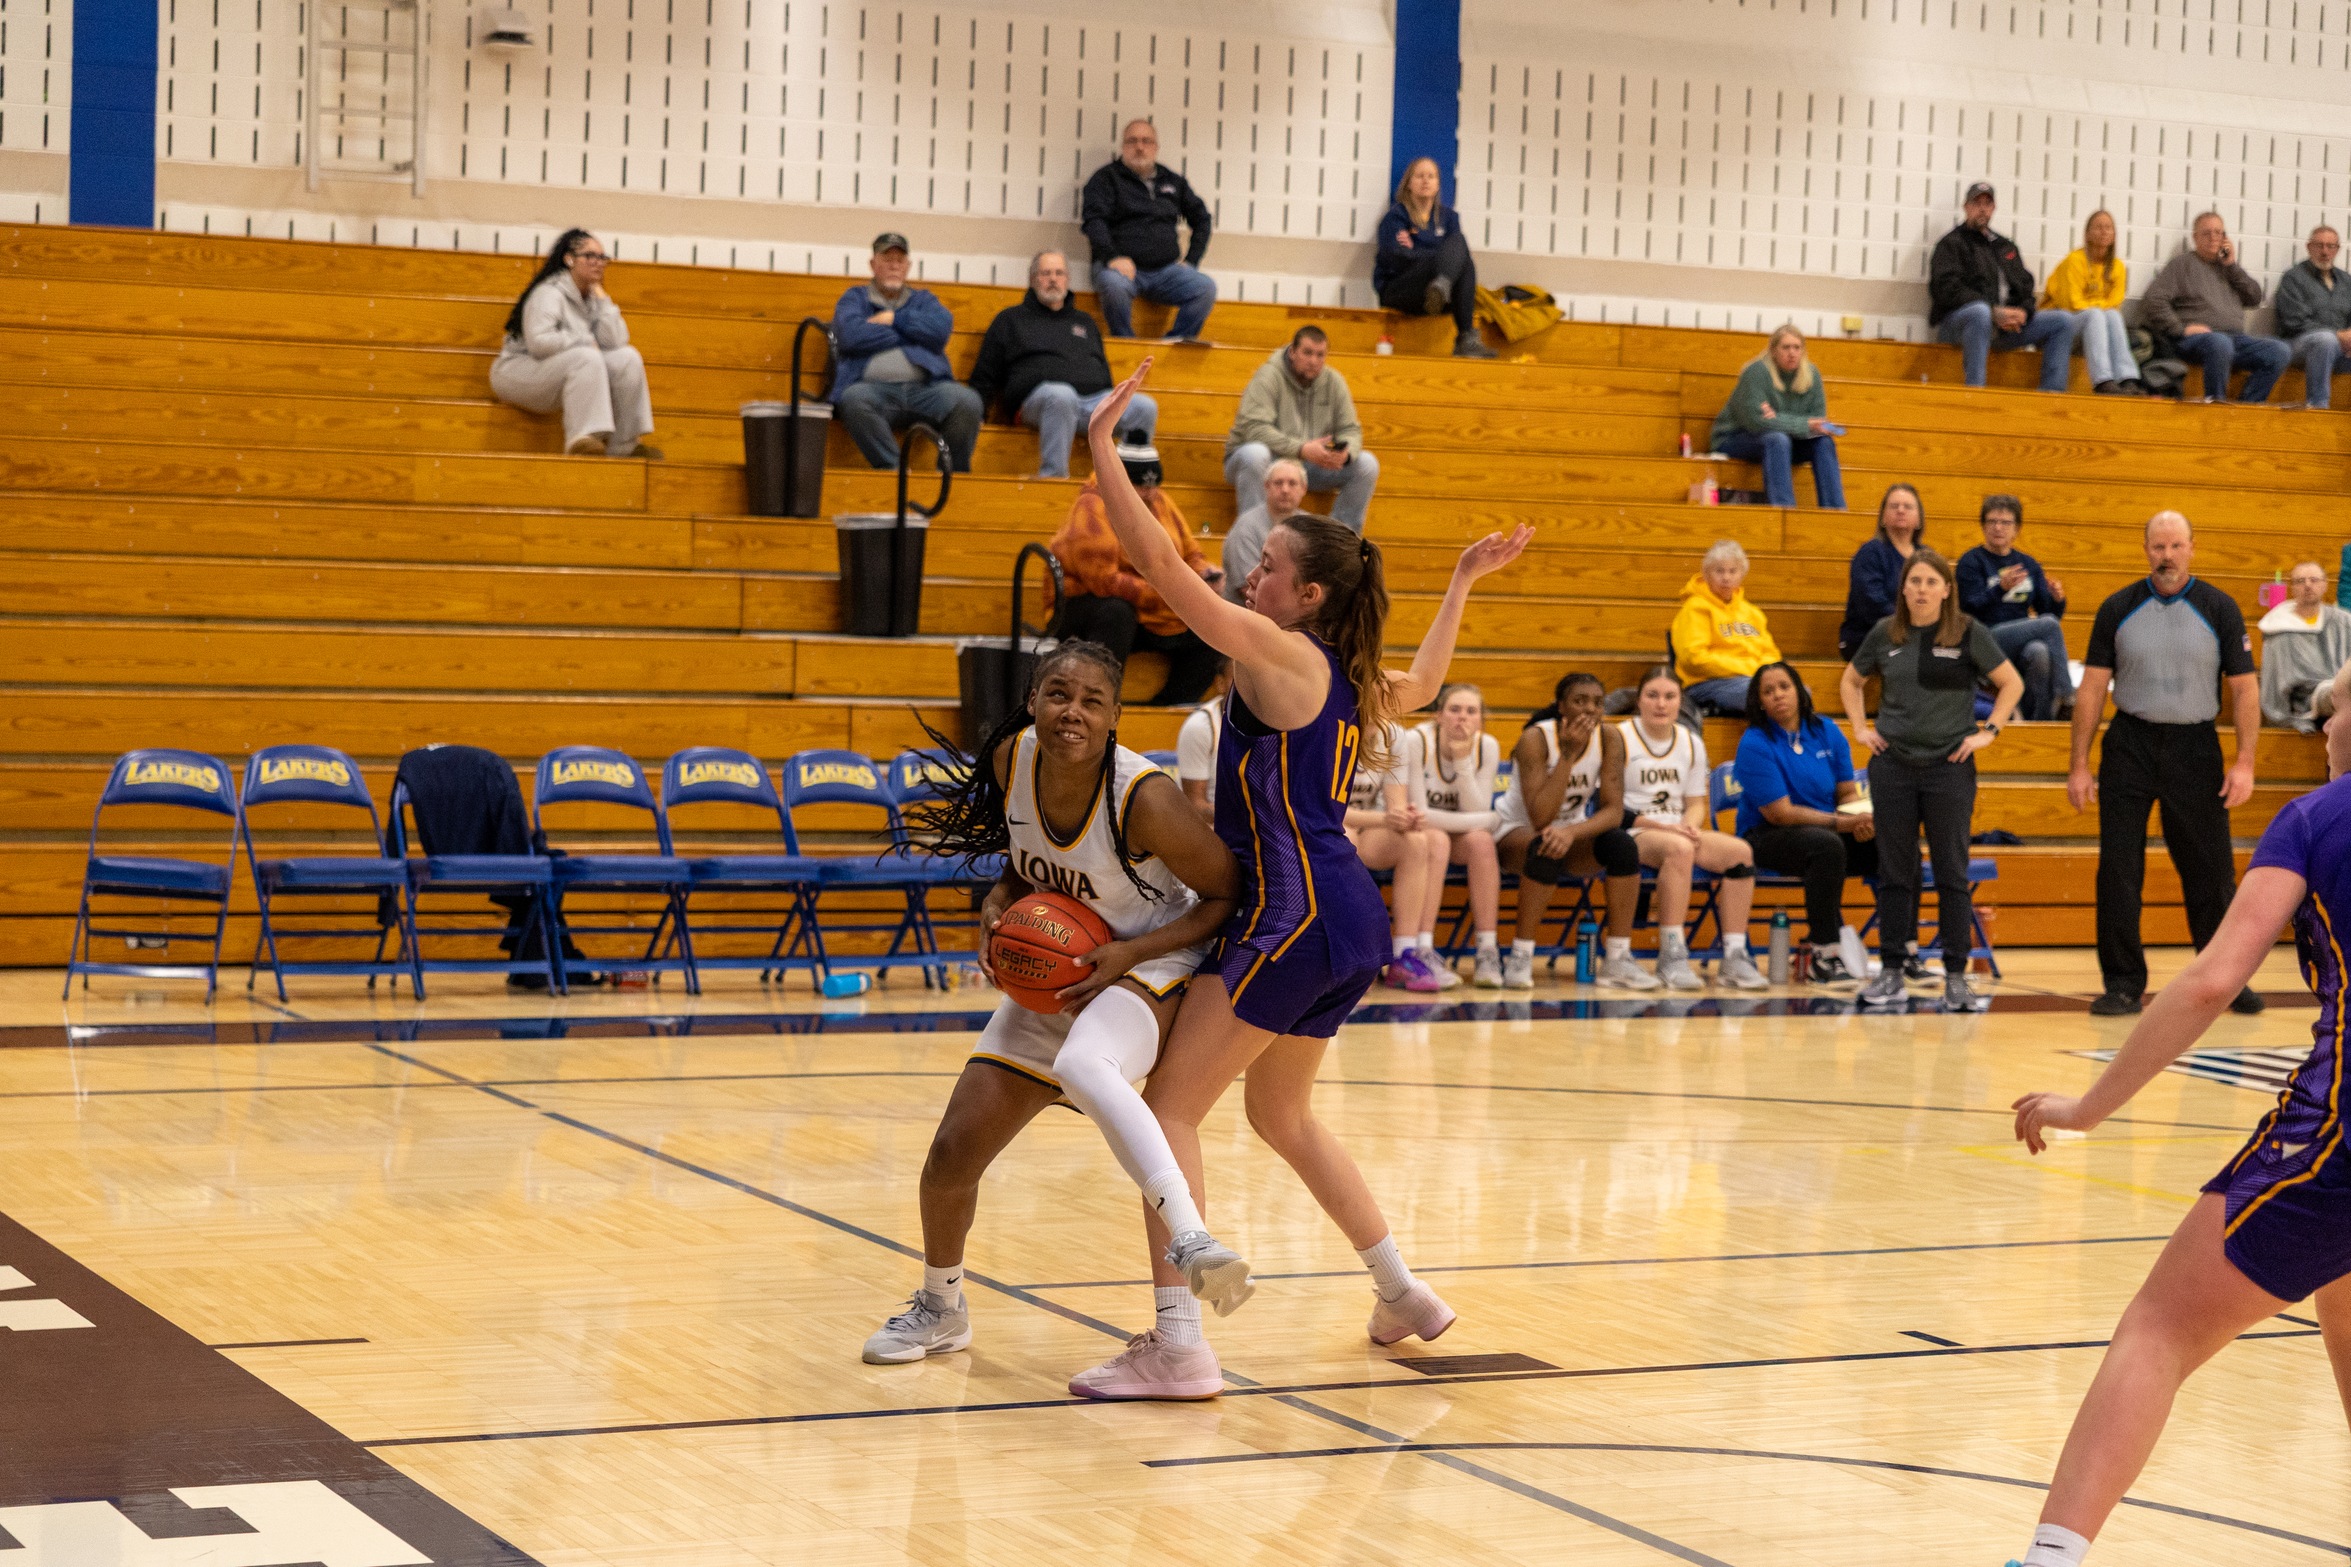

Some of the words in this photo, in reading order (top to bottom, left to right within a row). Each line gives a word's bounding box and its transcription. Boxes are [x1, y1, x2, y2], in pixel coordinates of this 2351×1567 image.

[260, 759, 350, 786] LAKERS
[552, 761, 635, 788] LAKERS
[680, 761, 760, 788] LAKERS
[1330, 719, 1360, 805] 12
[125, 761, 220, 793] LAKERS
[800, 763, 877, 790] LAKERS
[1640, 768, 1680, 785] IOWA
[1020, 848, 1101, 900] IOWA
[1004, 911, 1076, 947] SPALDING
[996, 943, 1057, 972] LEGACY
